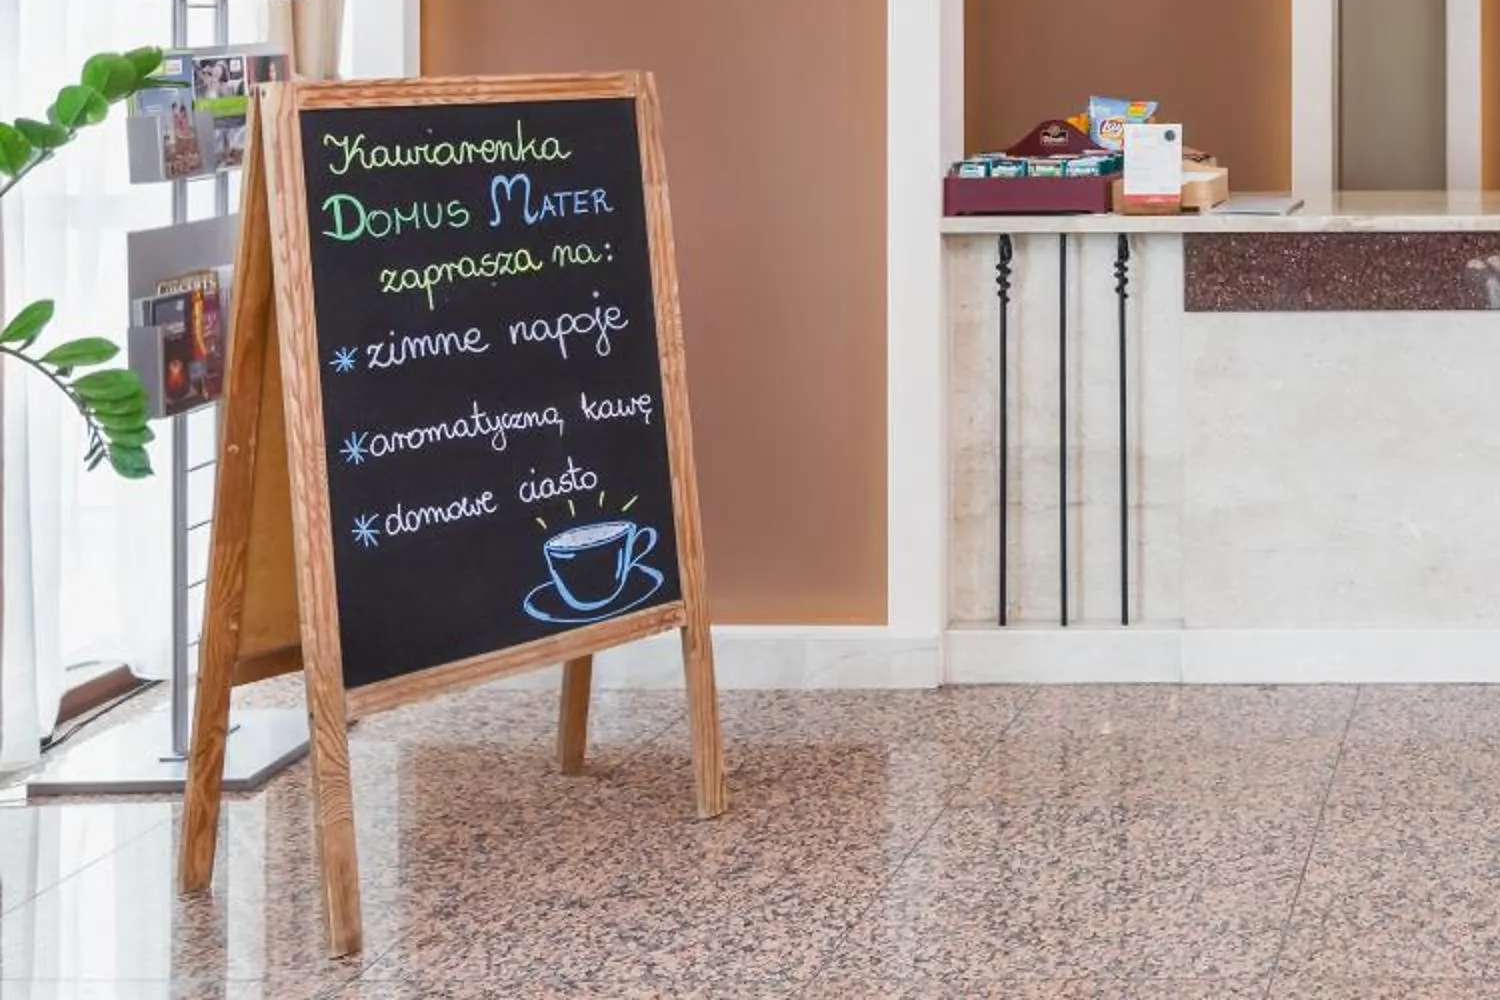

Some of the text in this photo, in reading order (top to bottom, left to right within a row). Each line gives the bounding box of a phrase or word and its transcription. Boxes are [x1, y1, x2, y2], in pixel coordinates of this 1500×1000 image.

[323, 119, 572, 175] Kawiarenka
[379, 241, 614, 310] zaprasza na:
[367, 290, 629, 369] zimne napoje
[369, 391, 653, 456] aromatyczną kawę
[385, 455, 598, 536] domowe ciasto
